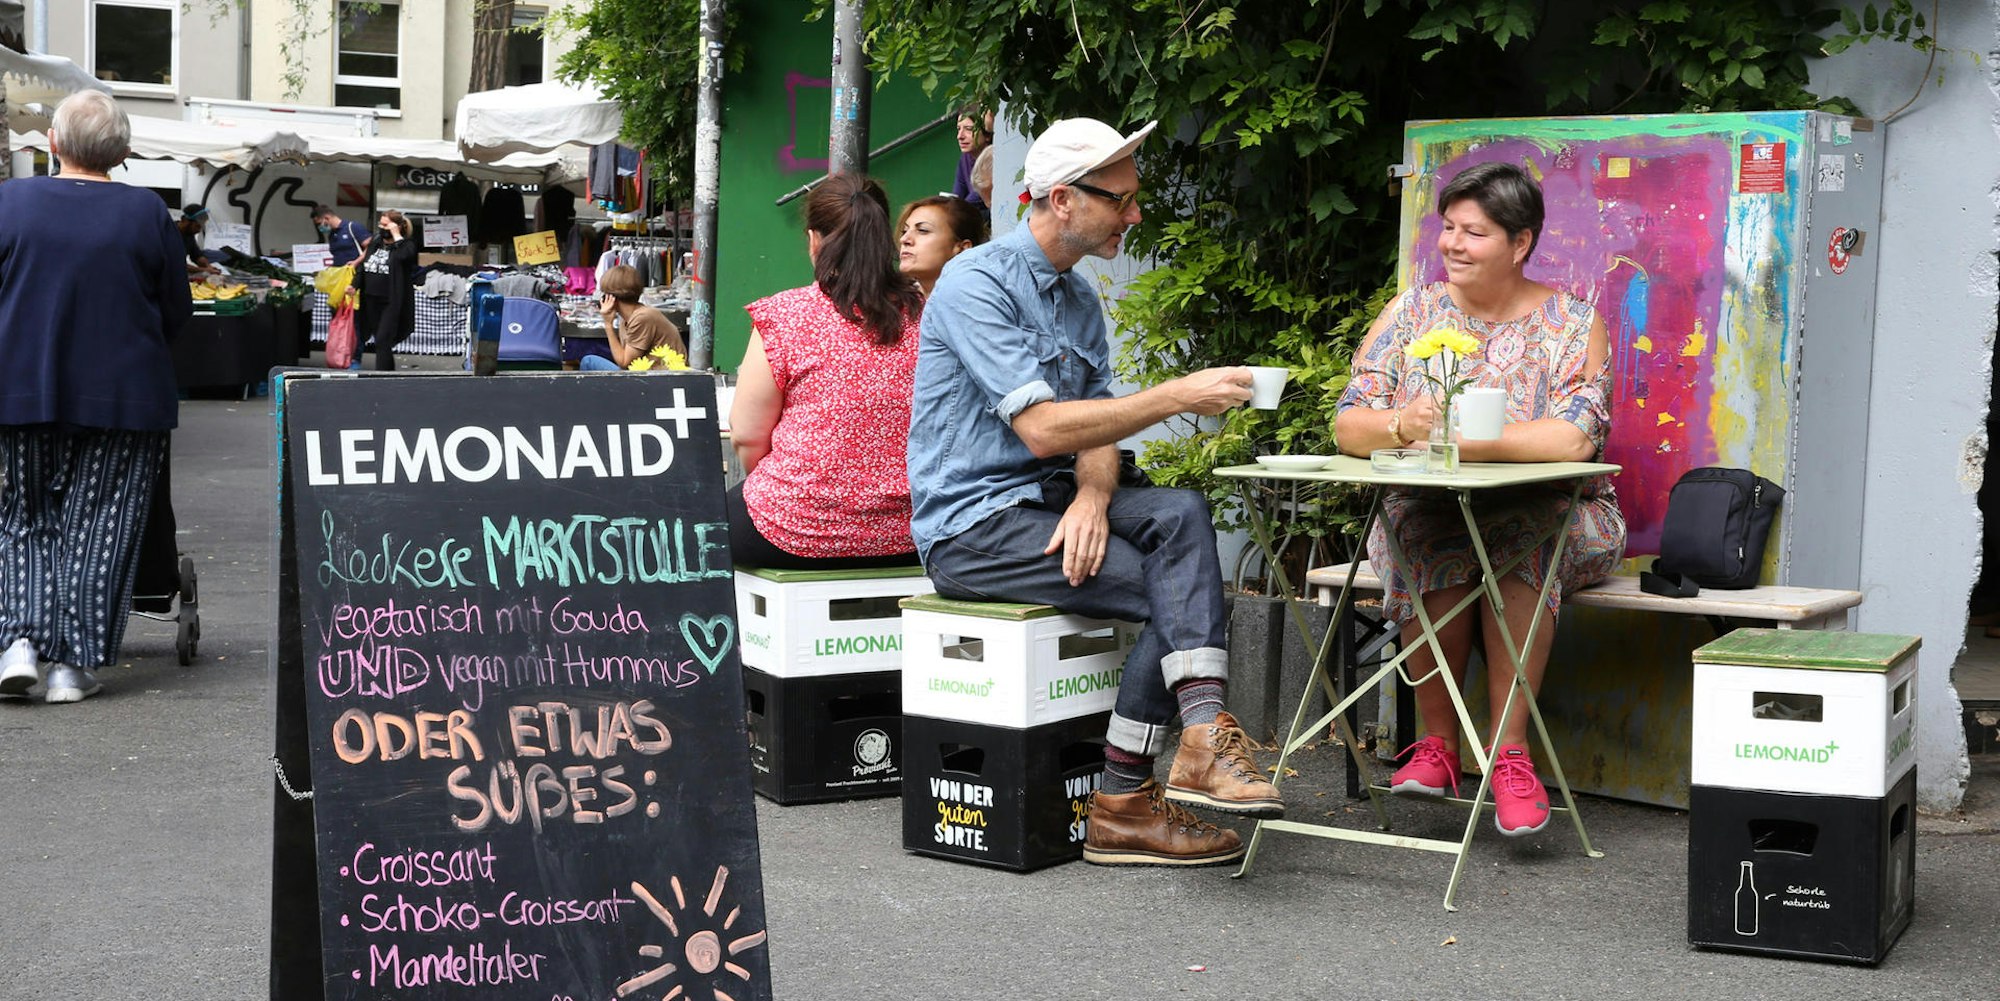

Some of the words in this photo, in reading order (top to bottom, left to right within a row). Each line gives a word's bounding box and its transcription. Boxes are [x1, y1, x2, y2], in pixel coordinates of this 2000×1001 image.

[481, 514, 733, 591] MARKTSTULLE
[496, 596, 544, 634] mit
[550, 597, 650, 635] Gouda
[318, 645, 431, 700] UND
[514, 644, 557, 687] mit
[562, 642, 701, 689] Hummus
[332, 707, 485, 764] ODER
[508, 700, 673, 759] ETWAS
[929, 776, 961, 802] VON
[963, 782, 994, 808] DER
[1065, 774, 1092, 799] VON
[937, 801, 987, 831] guten
[934, 822, 989, 852] SORTE.
[353, 841, 497, 887] Croissant
[1782, 897, 1831, 910] naturtrüb
[1785, 884, 1827, 896] Schorle
[360, 888, 636, 933] Schoko-Croissant
[369, 939, 547, 990] Mandeltaler
